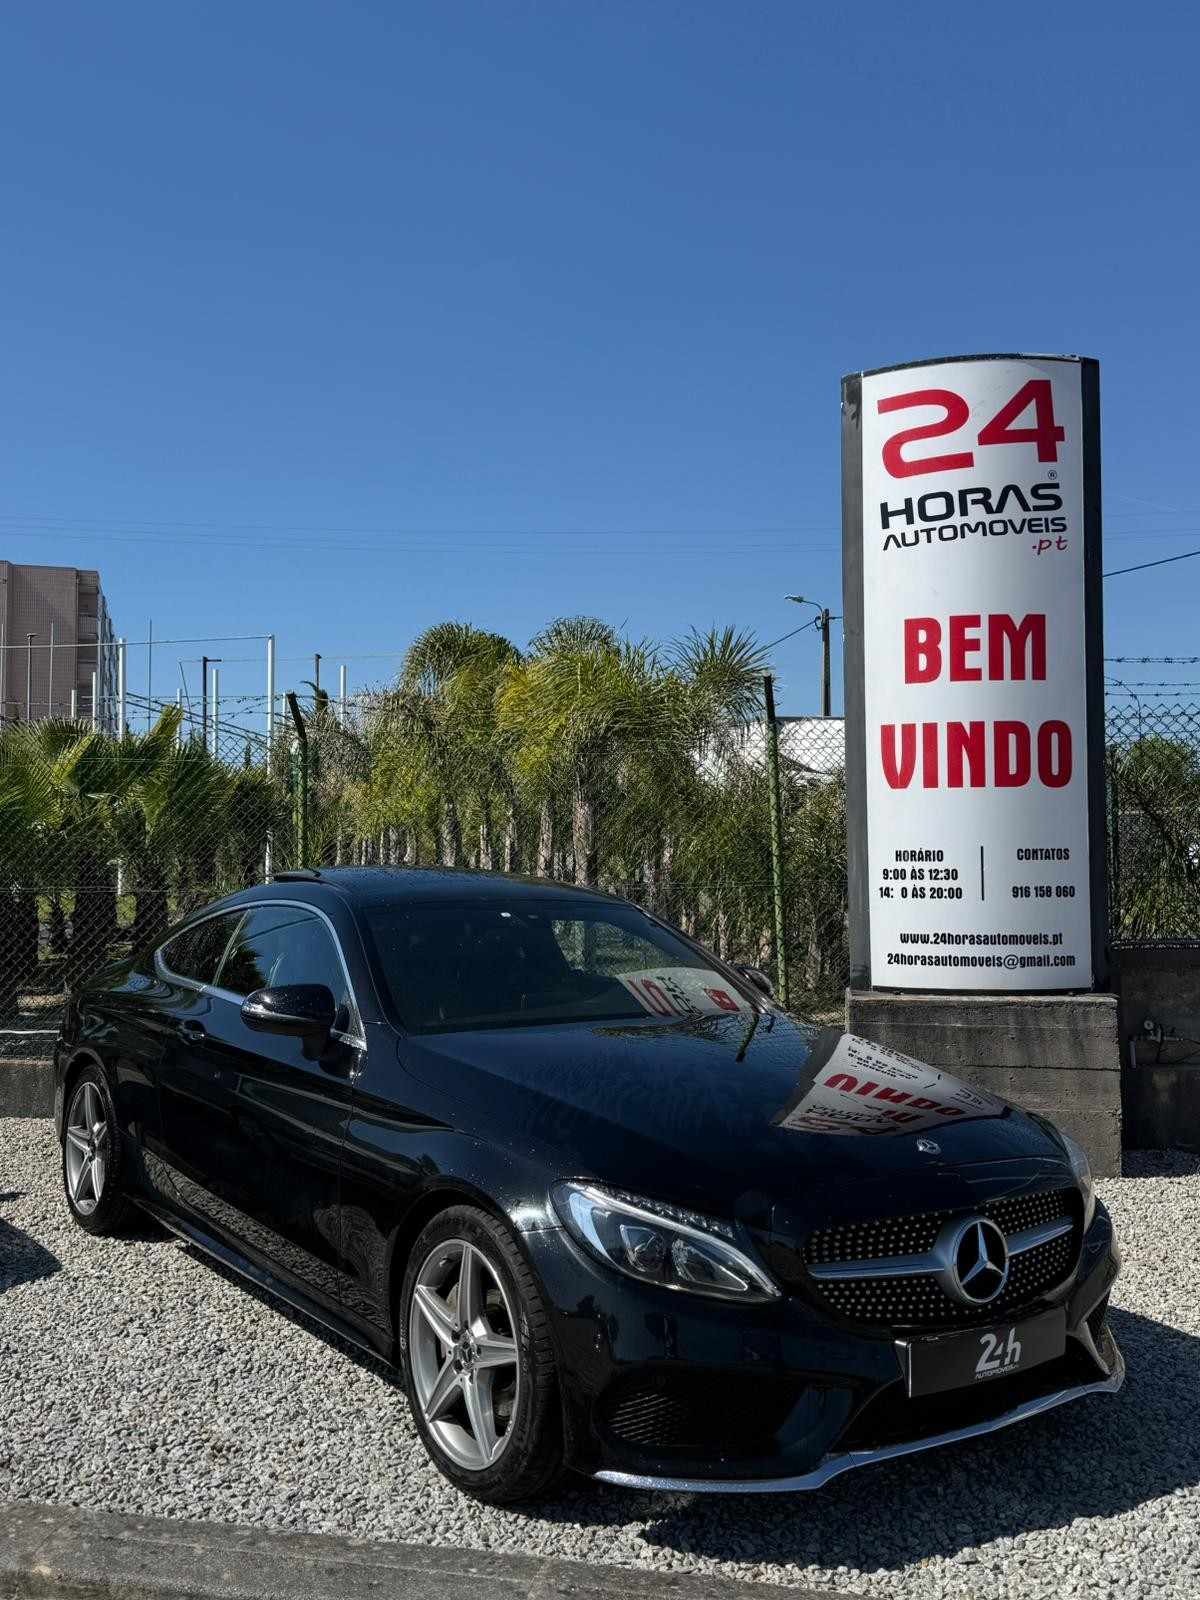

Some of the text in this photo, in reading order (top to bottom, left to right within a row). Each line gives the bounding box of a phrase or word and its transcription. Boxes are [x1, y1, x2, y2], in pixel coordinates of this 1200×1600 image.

[877, 379, 1065, 478] 24
[880, 482, 1063, 529] HORAS
[883, 516, 1068, 551] AUTOMOVEIS
[1032, 535, 1068, 555] .pt
[904, 613, 1046, 684] BEM
[880, 720, 1073, 790] VINDO
[895, 848, 944, 862] HORÁRIO
[1017, 848, 1070, 861] CONTATOS
[882, 868, 907, 881] 9:00
[928, 868, 959, 881] 12:30
[929, 887, 963, 899] 20:00
[1012, 886, 1031, 898] 916
[1055, 885, 1075, 898] 060
[900, 932, 1063, 945] www.24horasautomoveis.pt
[887, 953, 1076, 969] 24horasautomoveis@gmail.com
